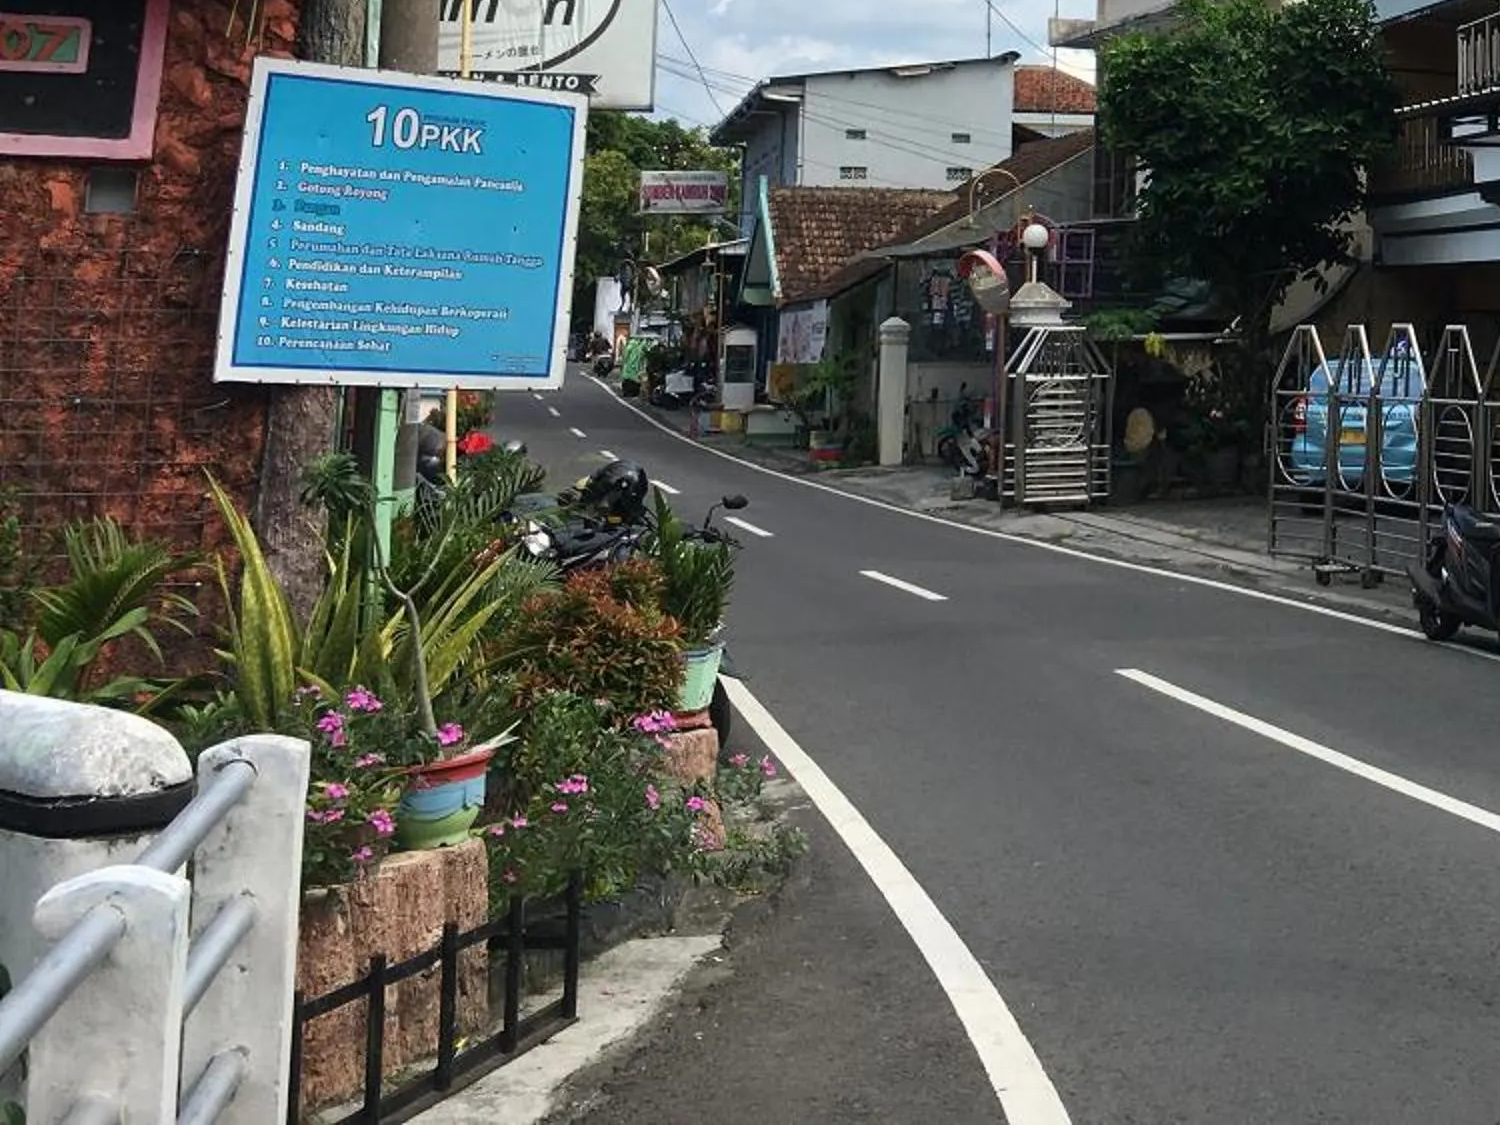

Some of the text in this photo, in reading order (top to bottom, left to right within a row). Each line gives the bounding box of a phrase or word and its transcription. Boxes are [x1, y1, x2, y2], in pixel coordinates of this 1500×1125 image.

[420, 124, 483, 155] PKK
[300, 161, 378, 179] Penghayatan
[379, 169, 401, 181] dan
[298, 181, 342, 198] Gotong
[292, 219, 346, 236] Sandang
[287, 258, 357, 274] Pendidikan
[359, 263, 381, 276] dan
[285, 277, 349, 293] Kesehatan
